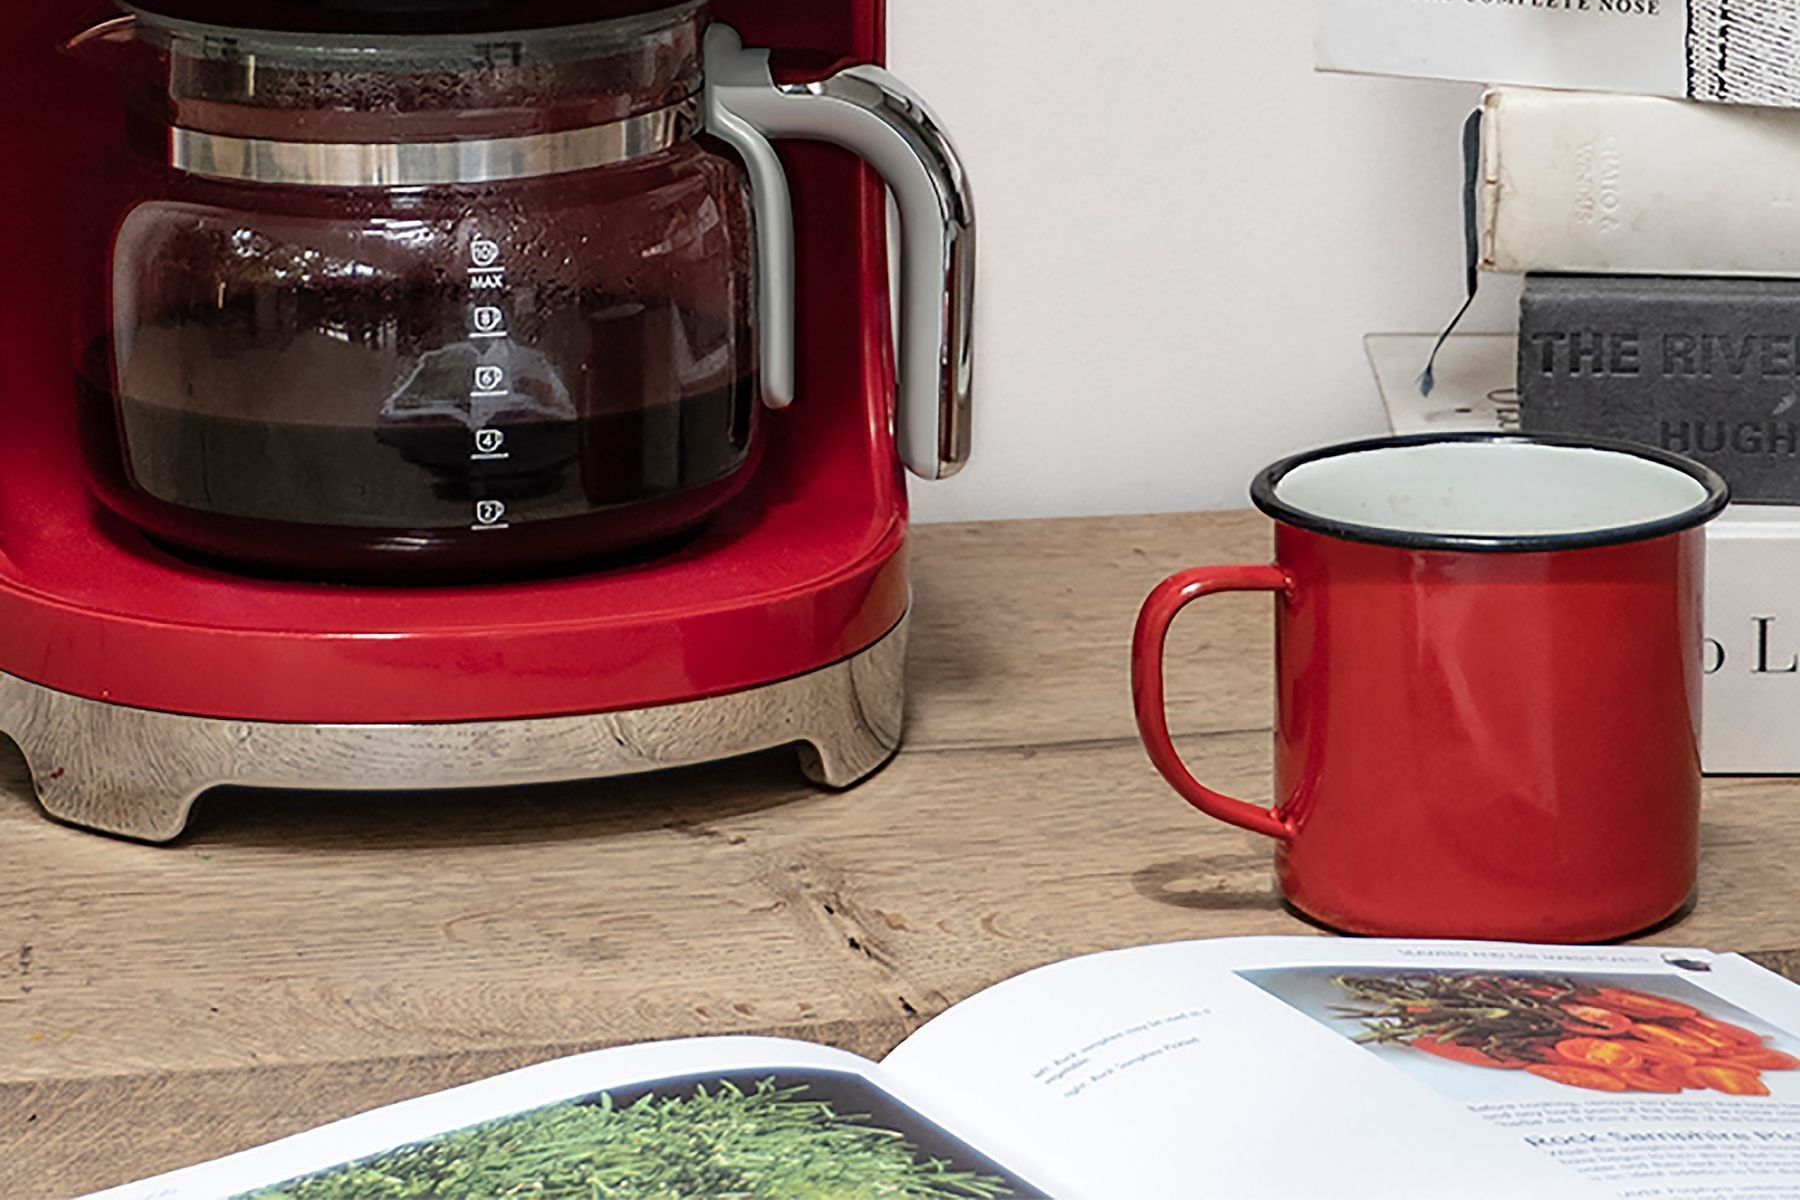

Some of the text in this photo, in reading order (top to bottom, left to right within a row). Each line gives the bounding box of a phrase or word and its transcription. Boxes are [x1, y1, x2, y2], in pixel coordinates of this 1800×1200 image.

[470, 274, 503, 289] MAX
[1531, 331, 1800, 379] THE RIVE
[1659, 420, 1797, 457] HUGH
